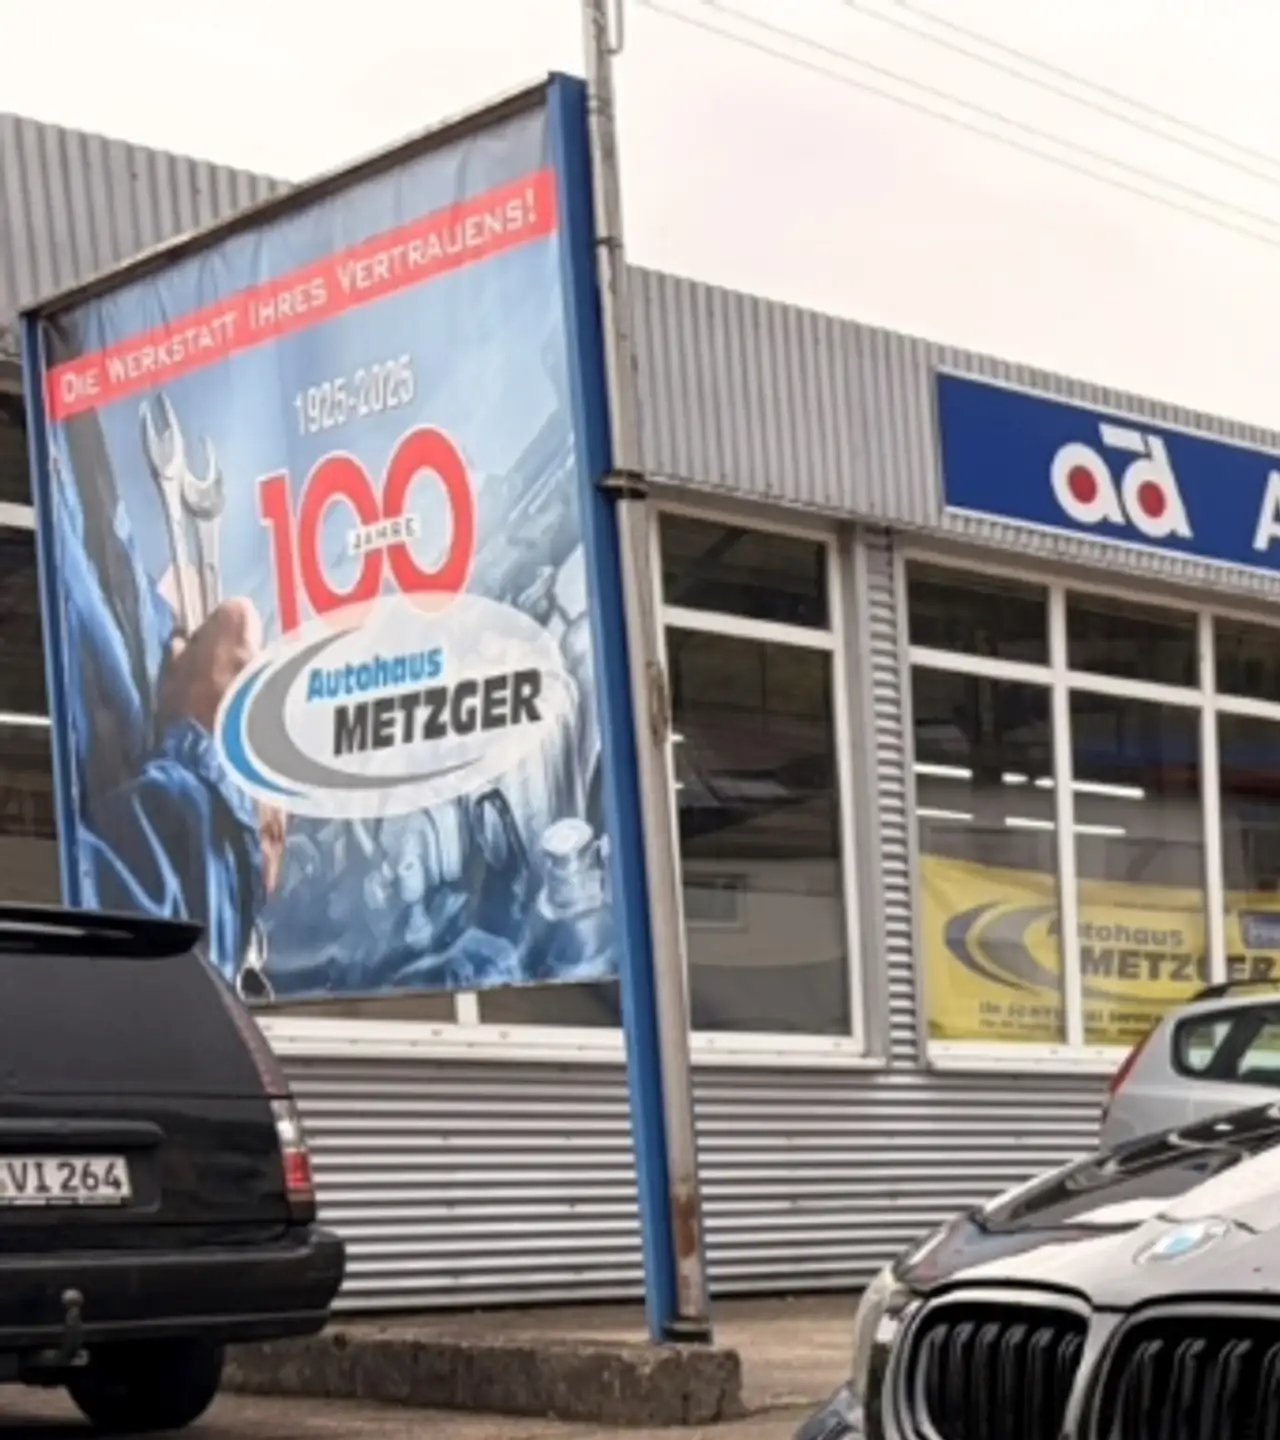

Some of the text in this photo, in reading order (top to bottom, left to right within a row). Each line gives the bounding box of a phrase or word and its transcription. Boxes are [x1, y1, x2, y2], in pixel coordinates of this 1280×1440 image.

[293, 353, 416, 436] 1925-2025
[256, 424, 477, 638] 100
[353, 517, 418, 550] JAHRE
[306, 648, 443, 703] Autohaus
[333, 668, 542, 757] METZGER
[1047, 916, 1185, 947] Atohaus
[6, 1161, 122, 1194] VI 264
